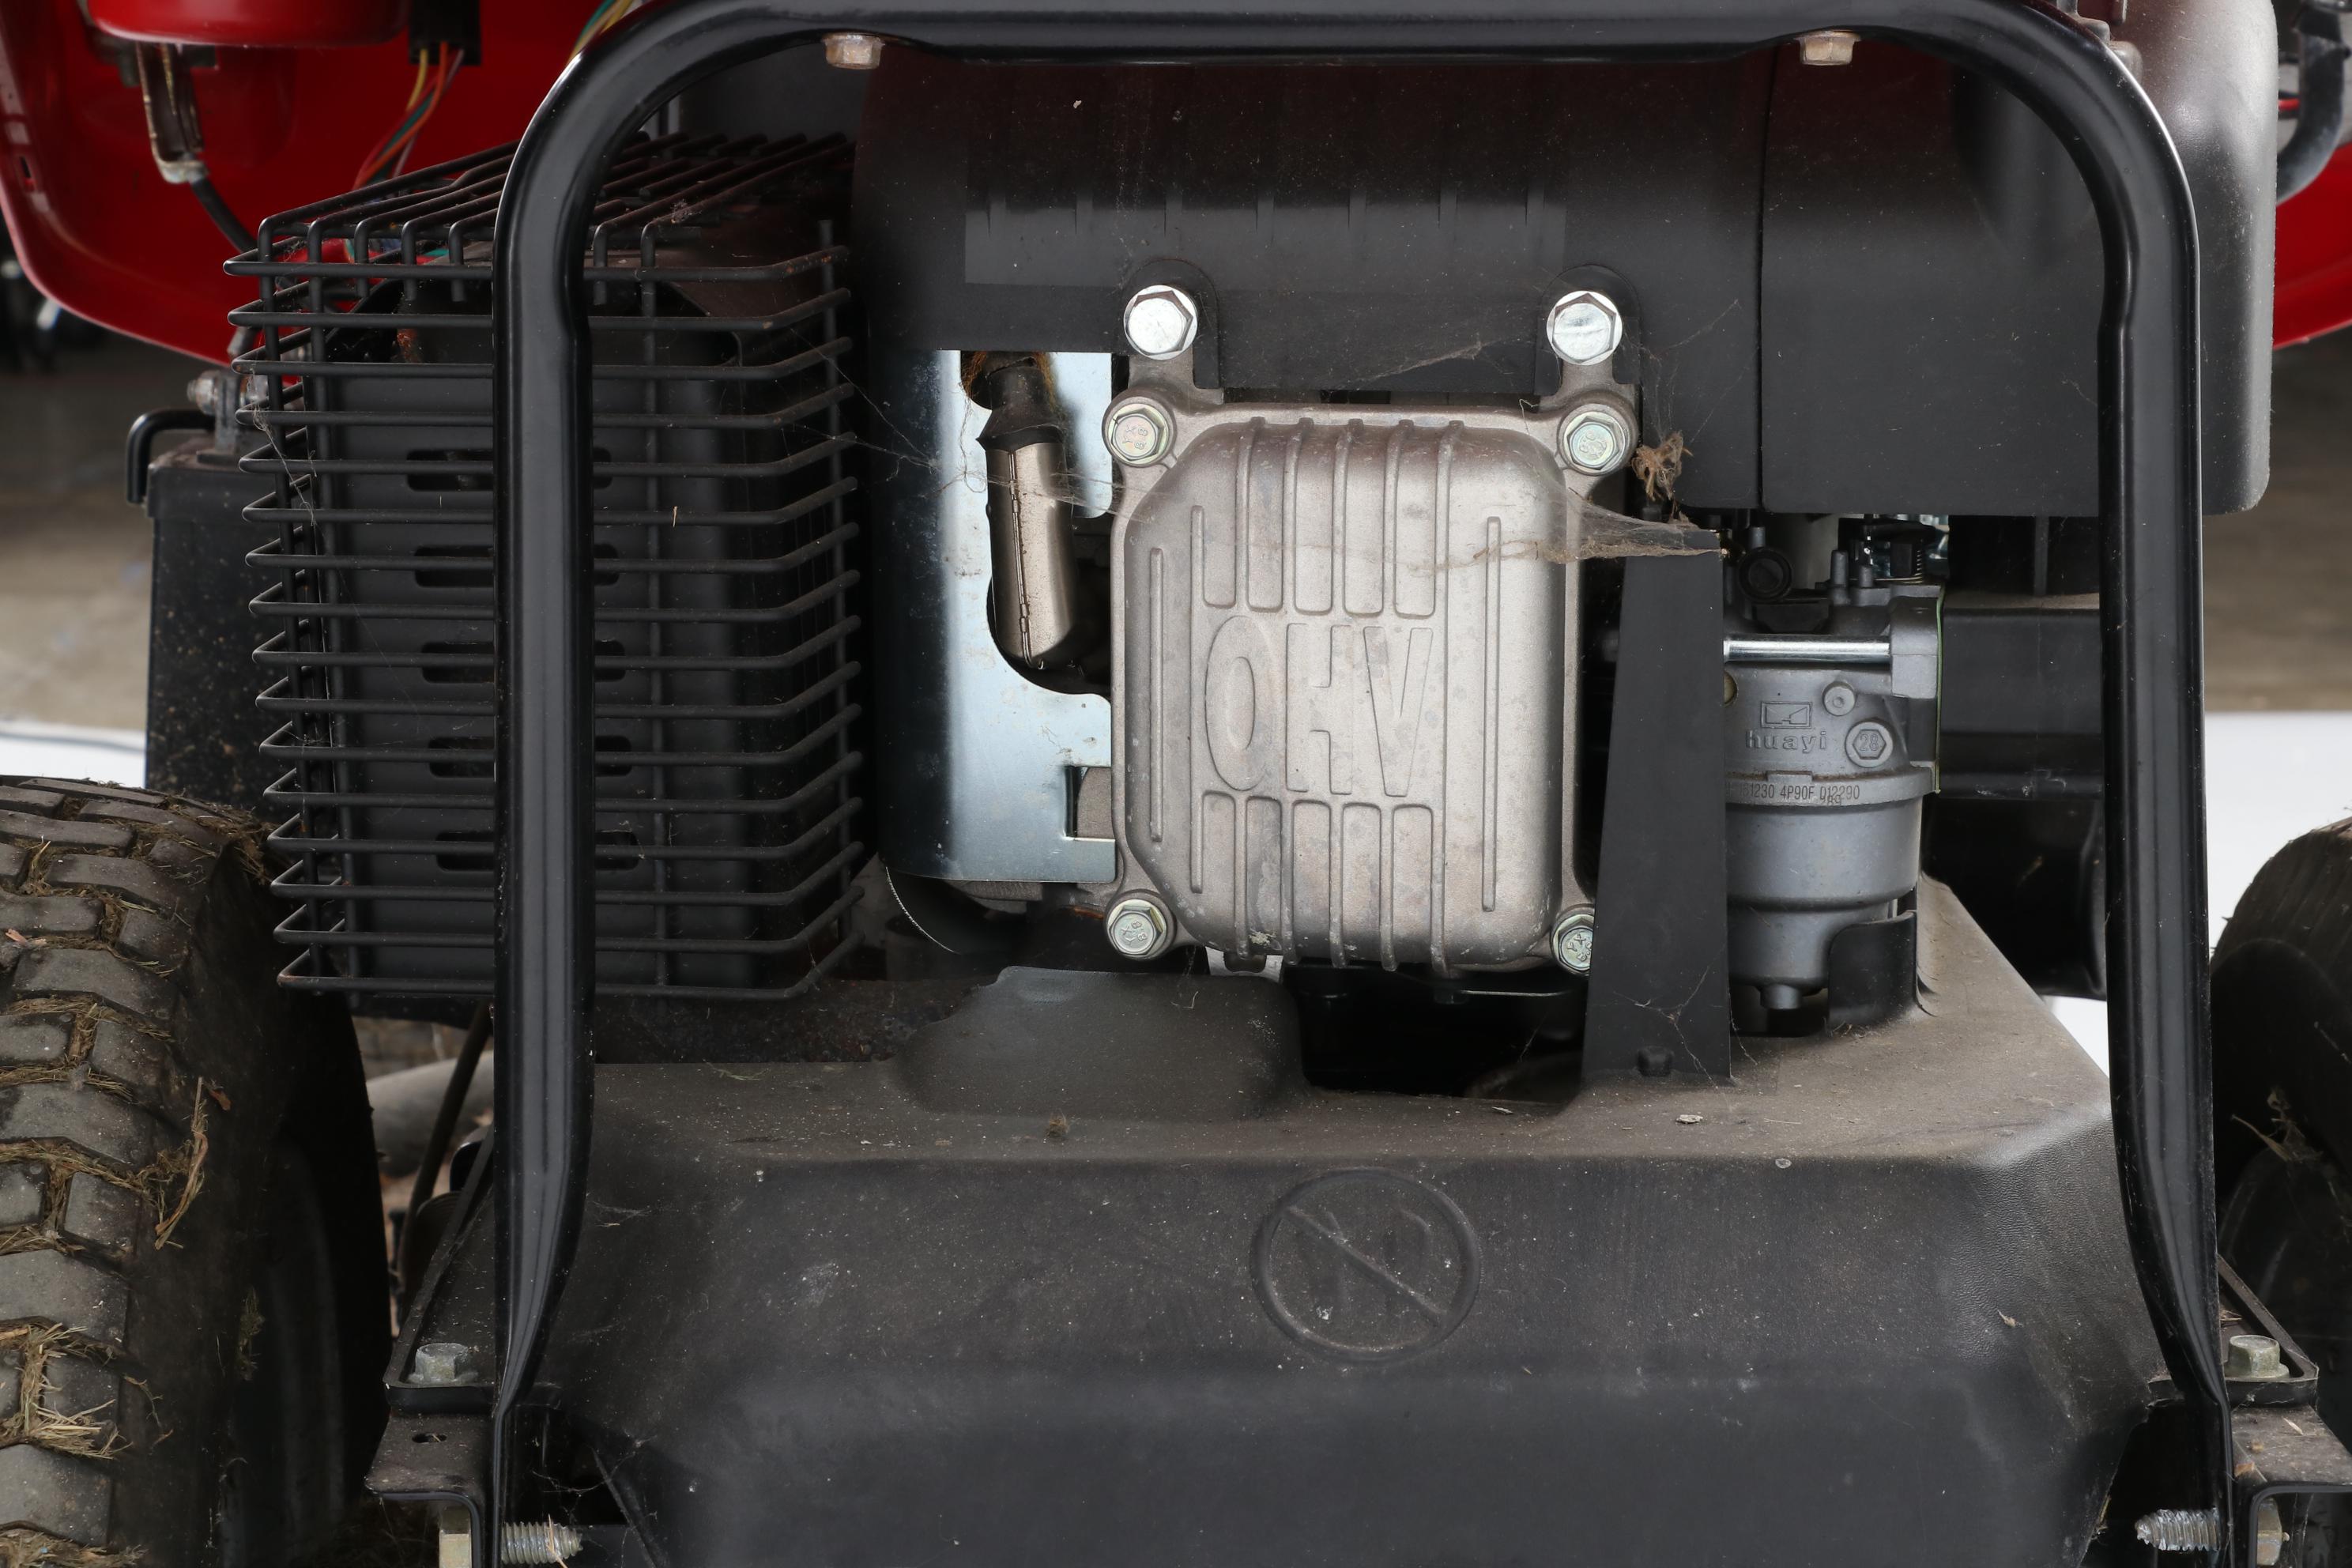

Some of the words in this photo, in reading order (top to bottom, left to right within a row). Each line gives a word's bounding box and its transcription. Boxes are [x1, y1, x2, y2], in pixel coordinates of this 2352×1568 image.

[1204, 614, 1434, 797] OHV
[1745, 729, 1828, 754] huayi
[1859, 733, 1881, 752] 28
